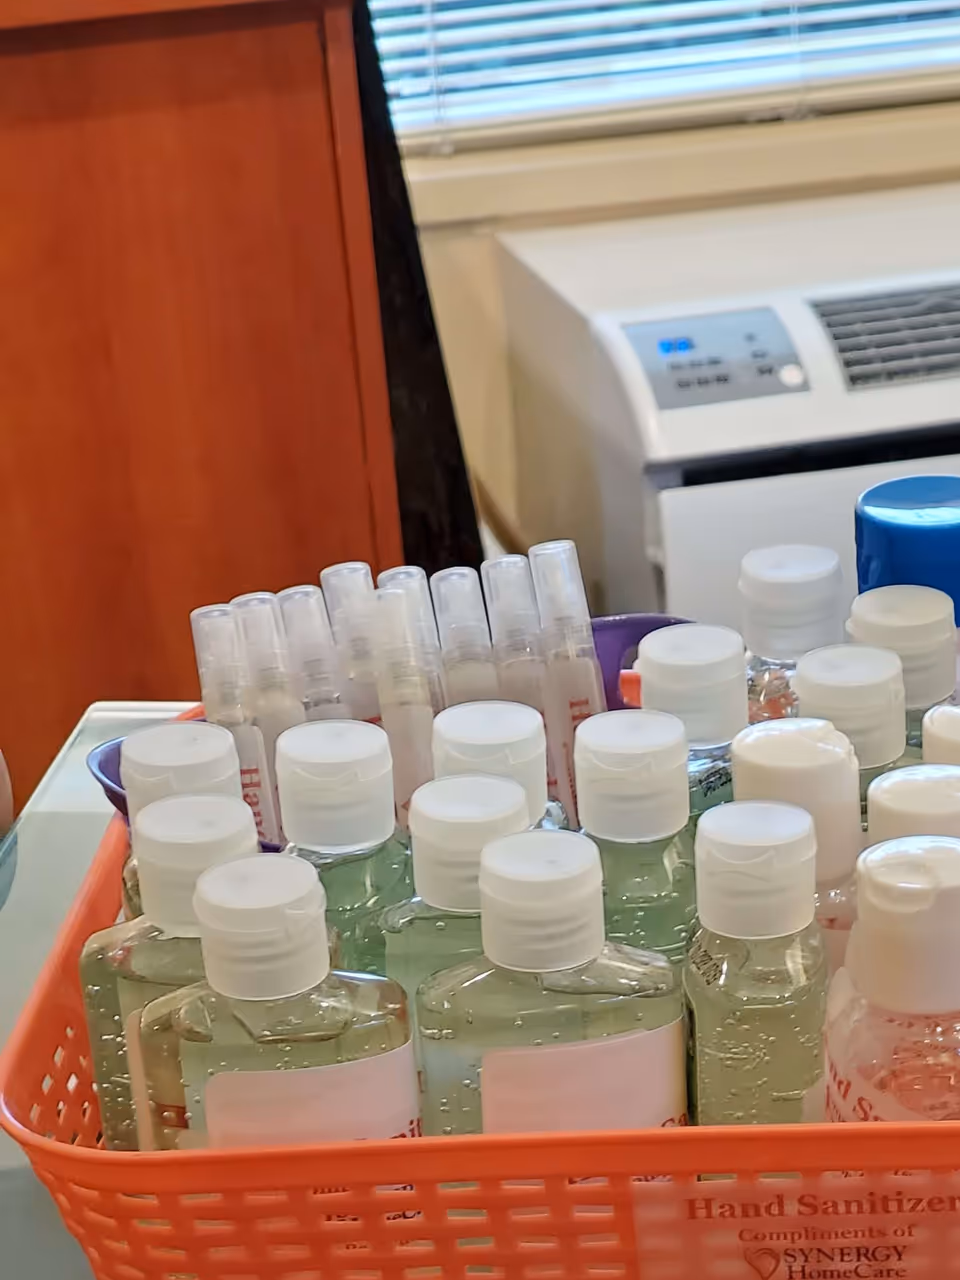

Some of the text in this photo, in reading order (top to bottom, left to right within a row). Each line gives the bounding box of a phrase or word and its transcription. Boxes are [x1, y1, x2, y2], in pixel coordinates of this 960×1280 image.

[685, 1193, 785, 1220] Hand
[738, 1223, 918, 1244] Compliments of
[783, 1245, 907, 1263] SYNERGY
[786, 1263, 906, 1280] HomeCare
